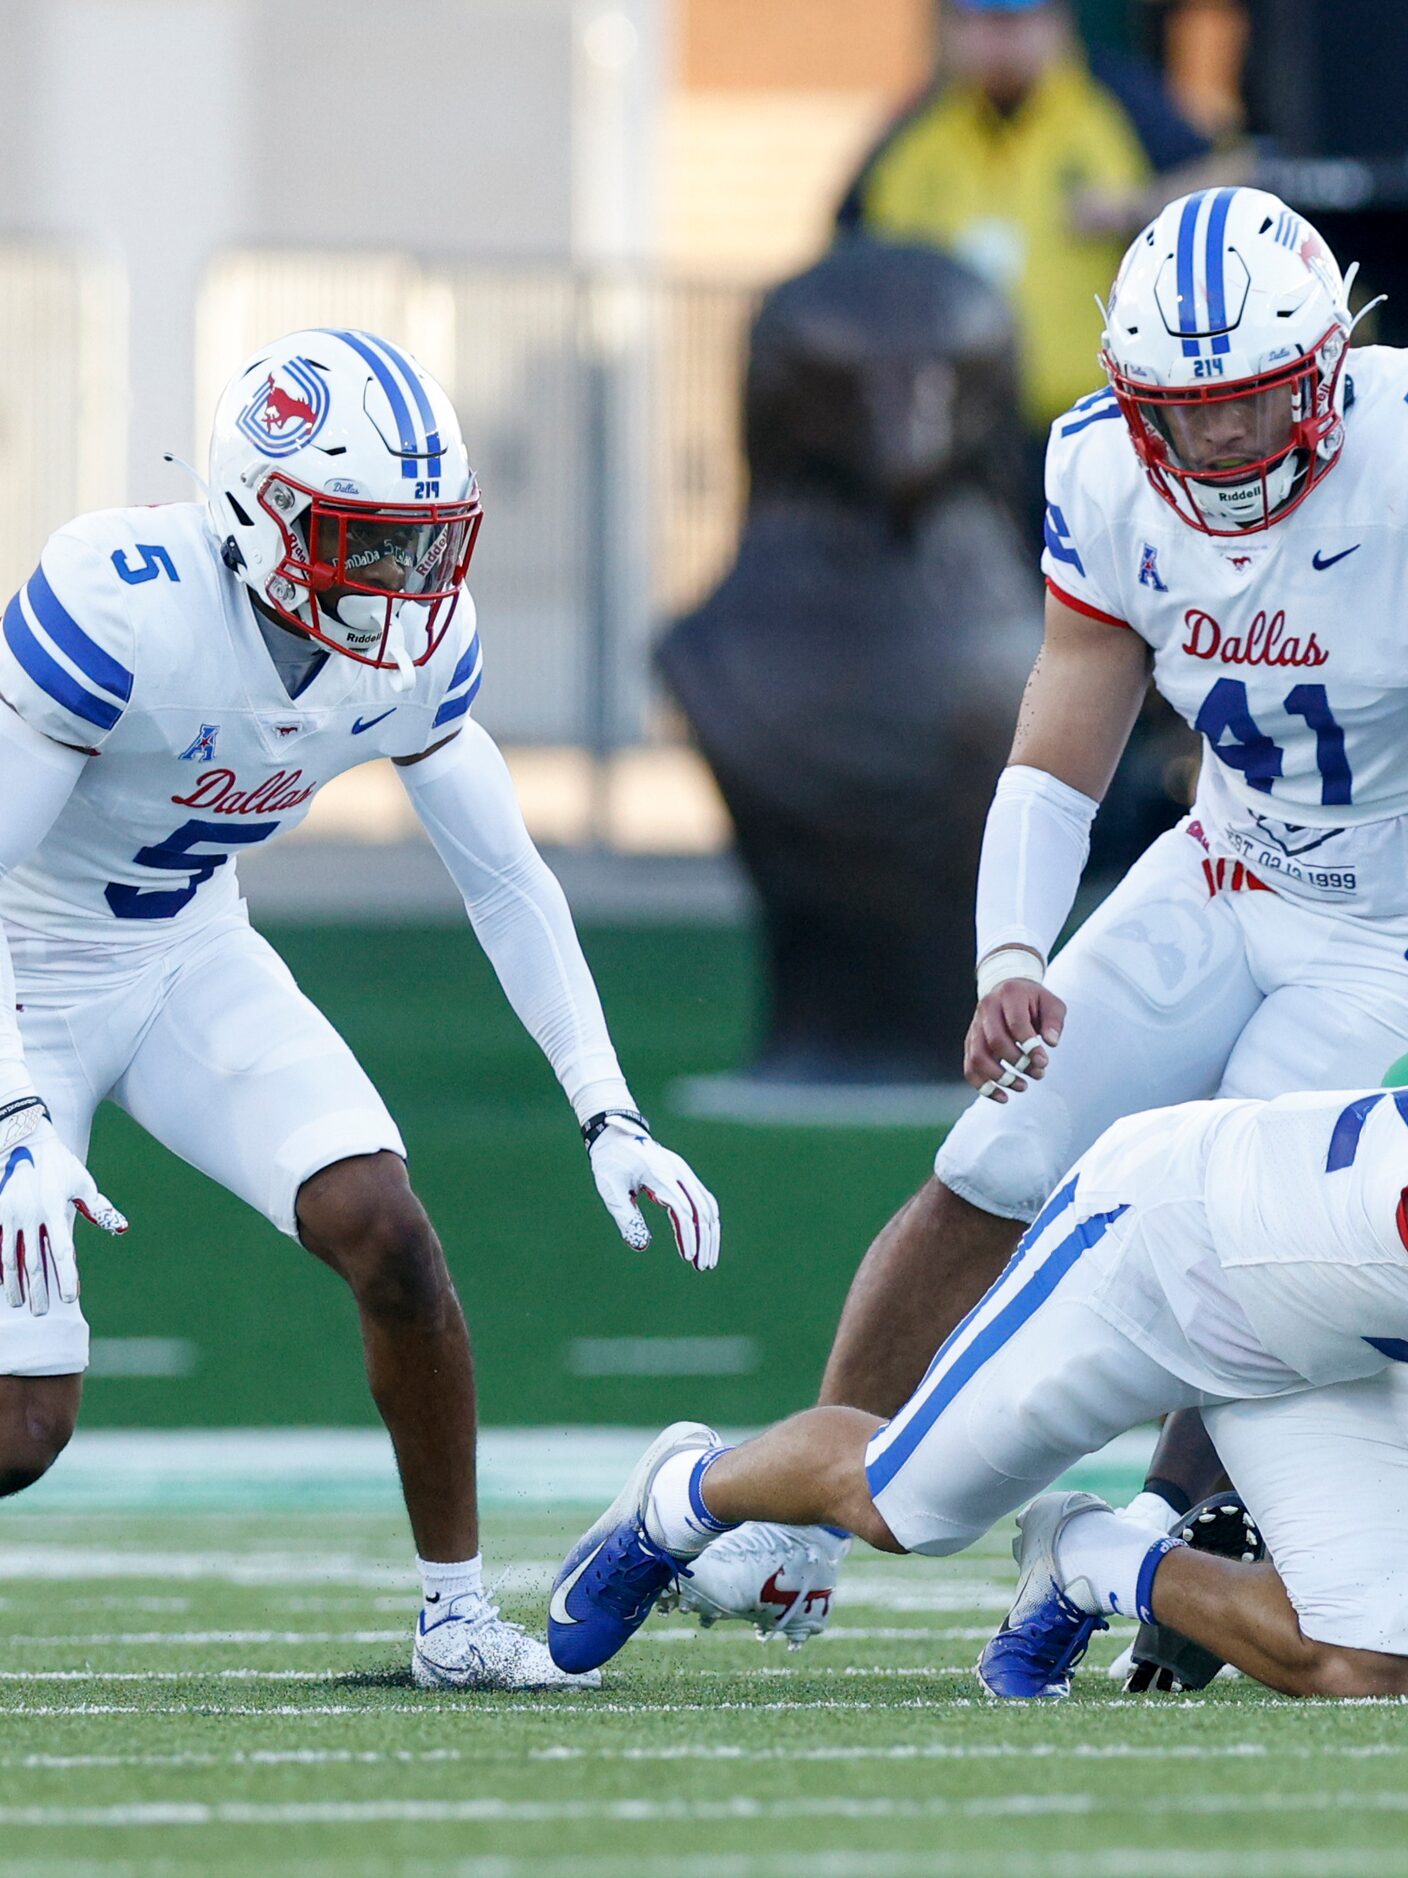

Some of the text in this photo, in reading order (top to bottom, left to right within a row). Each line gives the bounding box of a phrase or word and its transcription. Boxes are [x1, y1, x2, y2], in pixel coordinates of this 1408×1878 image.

[1193, 357, 1224, 378] 214
[333, 481, 359, 495] Dallas
[415, 481, 440, 499] 214
[1218, 486, 1261, 502] Riddell
[110, 544, 181, 585] 5
[332, 549, 380, 570] DnDaDa
[347, 632, 383, 644] Riddell
[1182, 609, 1329, 667] Dallas
[1194, 677, 1353, 806] 41
[171, 768, 317, 814] Dallas
[104, 818, 282, 919] 5
[1308, 872, 1356, 889] 1999
